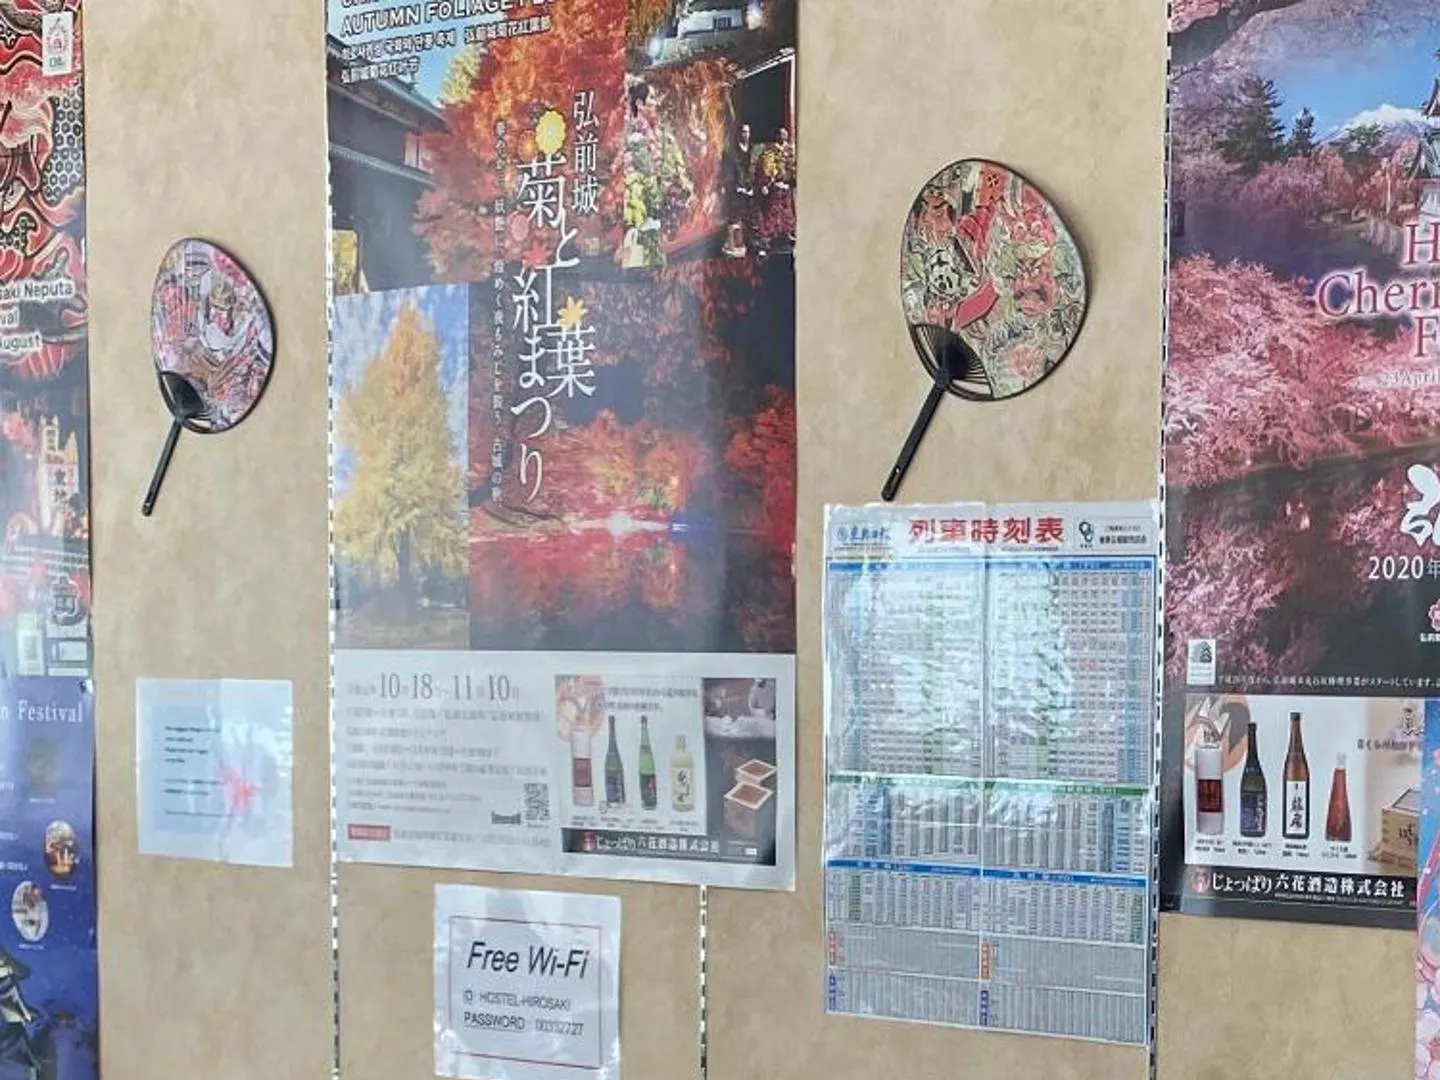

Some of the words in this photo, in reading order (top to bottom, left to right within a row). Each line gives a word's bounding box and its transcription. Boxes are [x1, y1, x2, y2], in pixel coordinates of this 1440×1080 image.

[340, 5, 421, 37] AUTUMN
[572, 91, 600, 214] 弘前城
[24, 281, 73, 298] Neputa
[0, 334, 40, 353] ugust
[907, 516, 1067, 545] 列車時刻表
[17, 700, 83, 723] Festival
[466, 940, 520, 973] Free
[528, 945, 591, 979] Wi-Fi
[463, 1011, 525, 1030] PASSWORD
